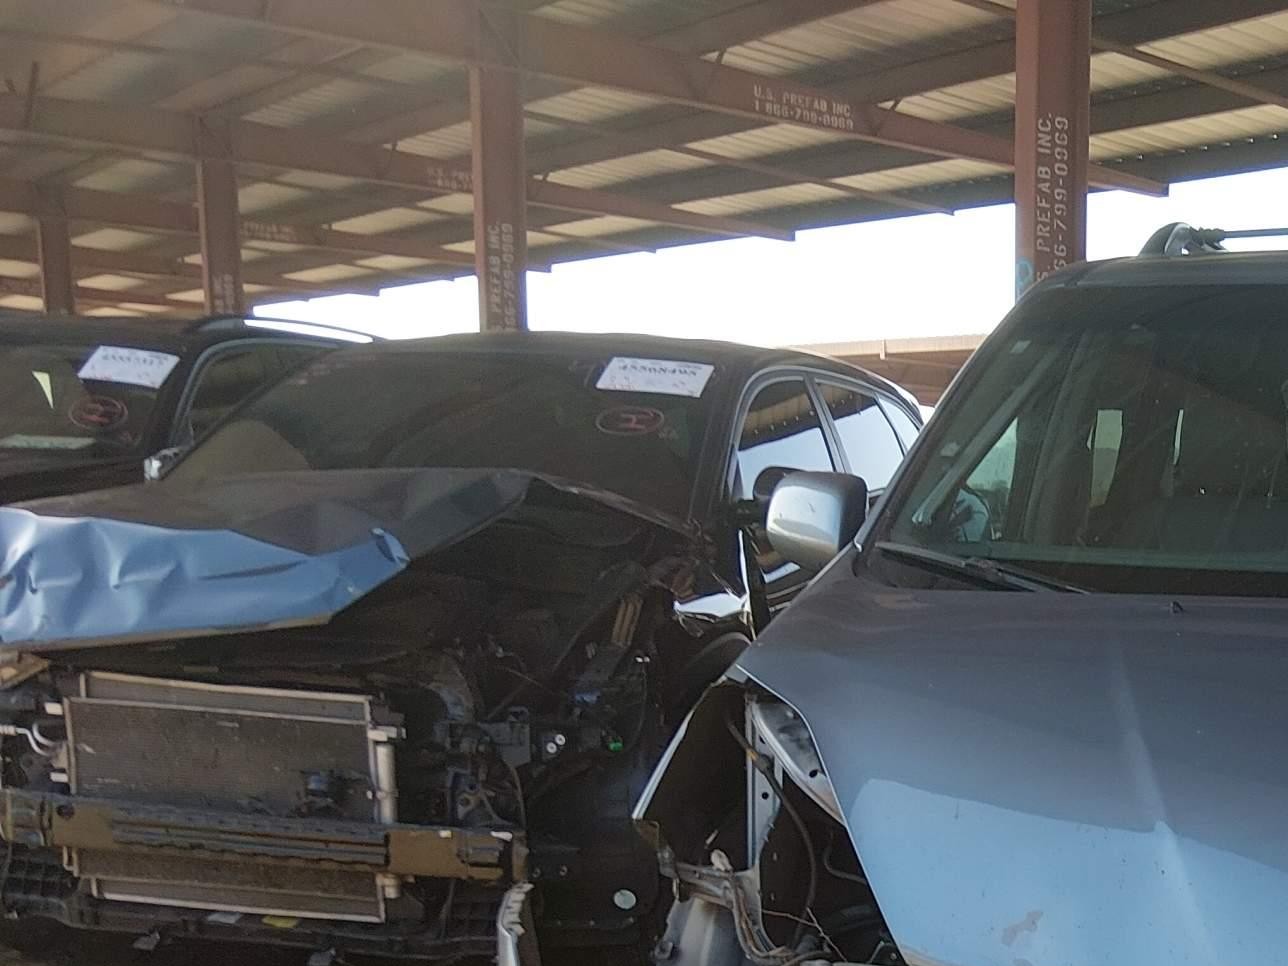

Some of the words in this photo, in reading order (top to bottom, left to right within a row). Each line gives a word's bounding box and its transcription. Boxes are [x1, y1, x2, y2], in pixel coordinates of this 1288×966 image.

[1037, 113, 1052, 154] INC.
[1036, 166, 1052, 252] PREFAB
[1054, 117, 1069, 272] 66-799-0969
